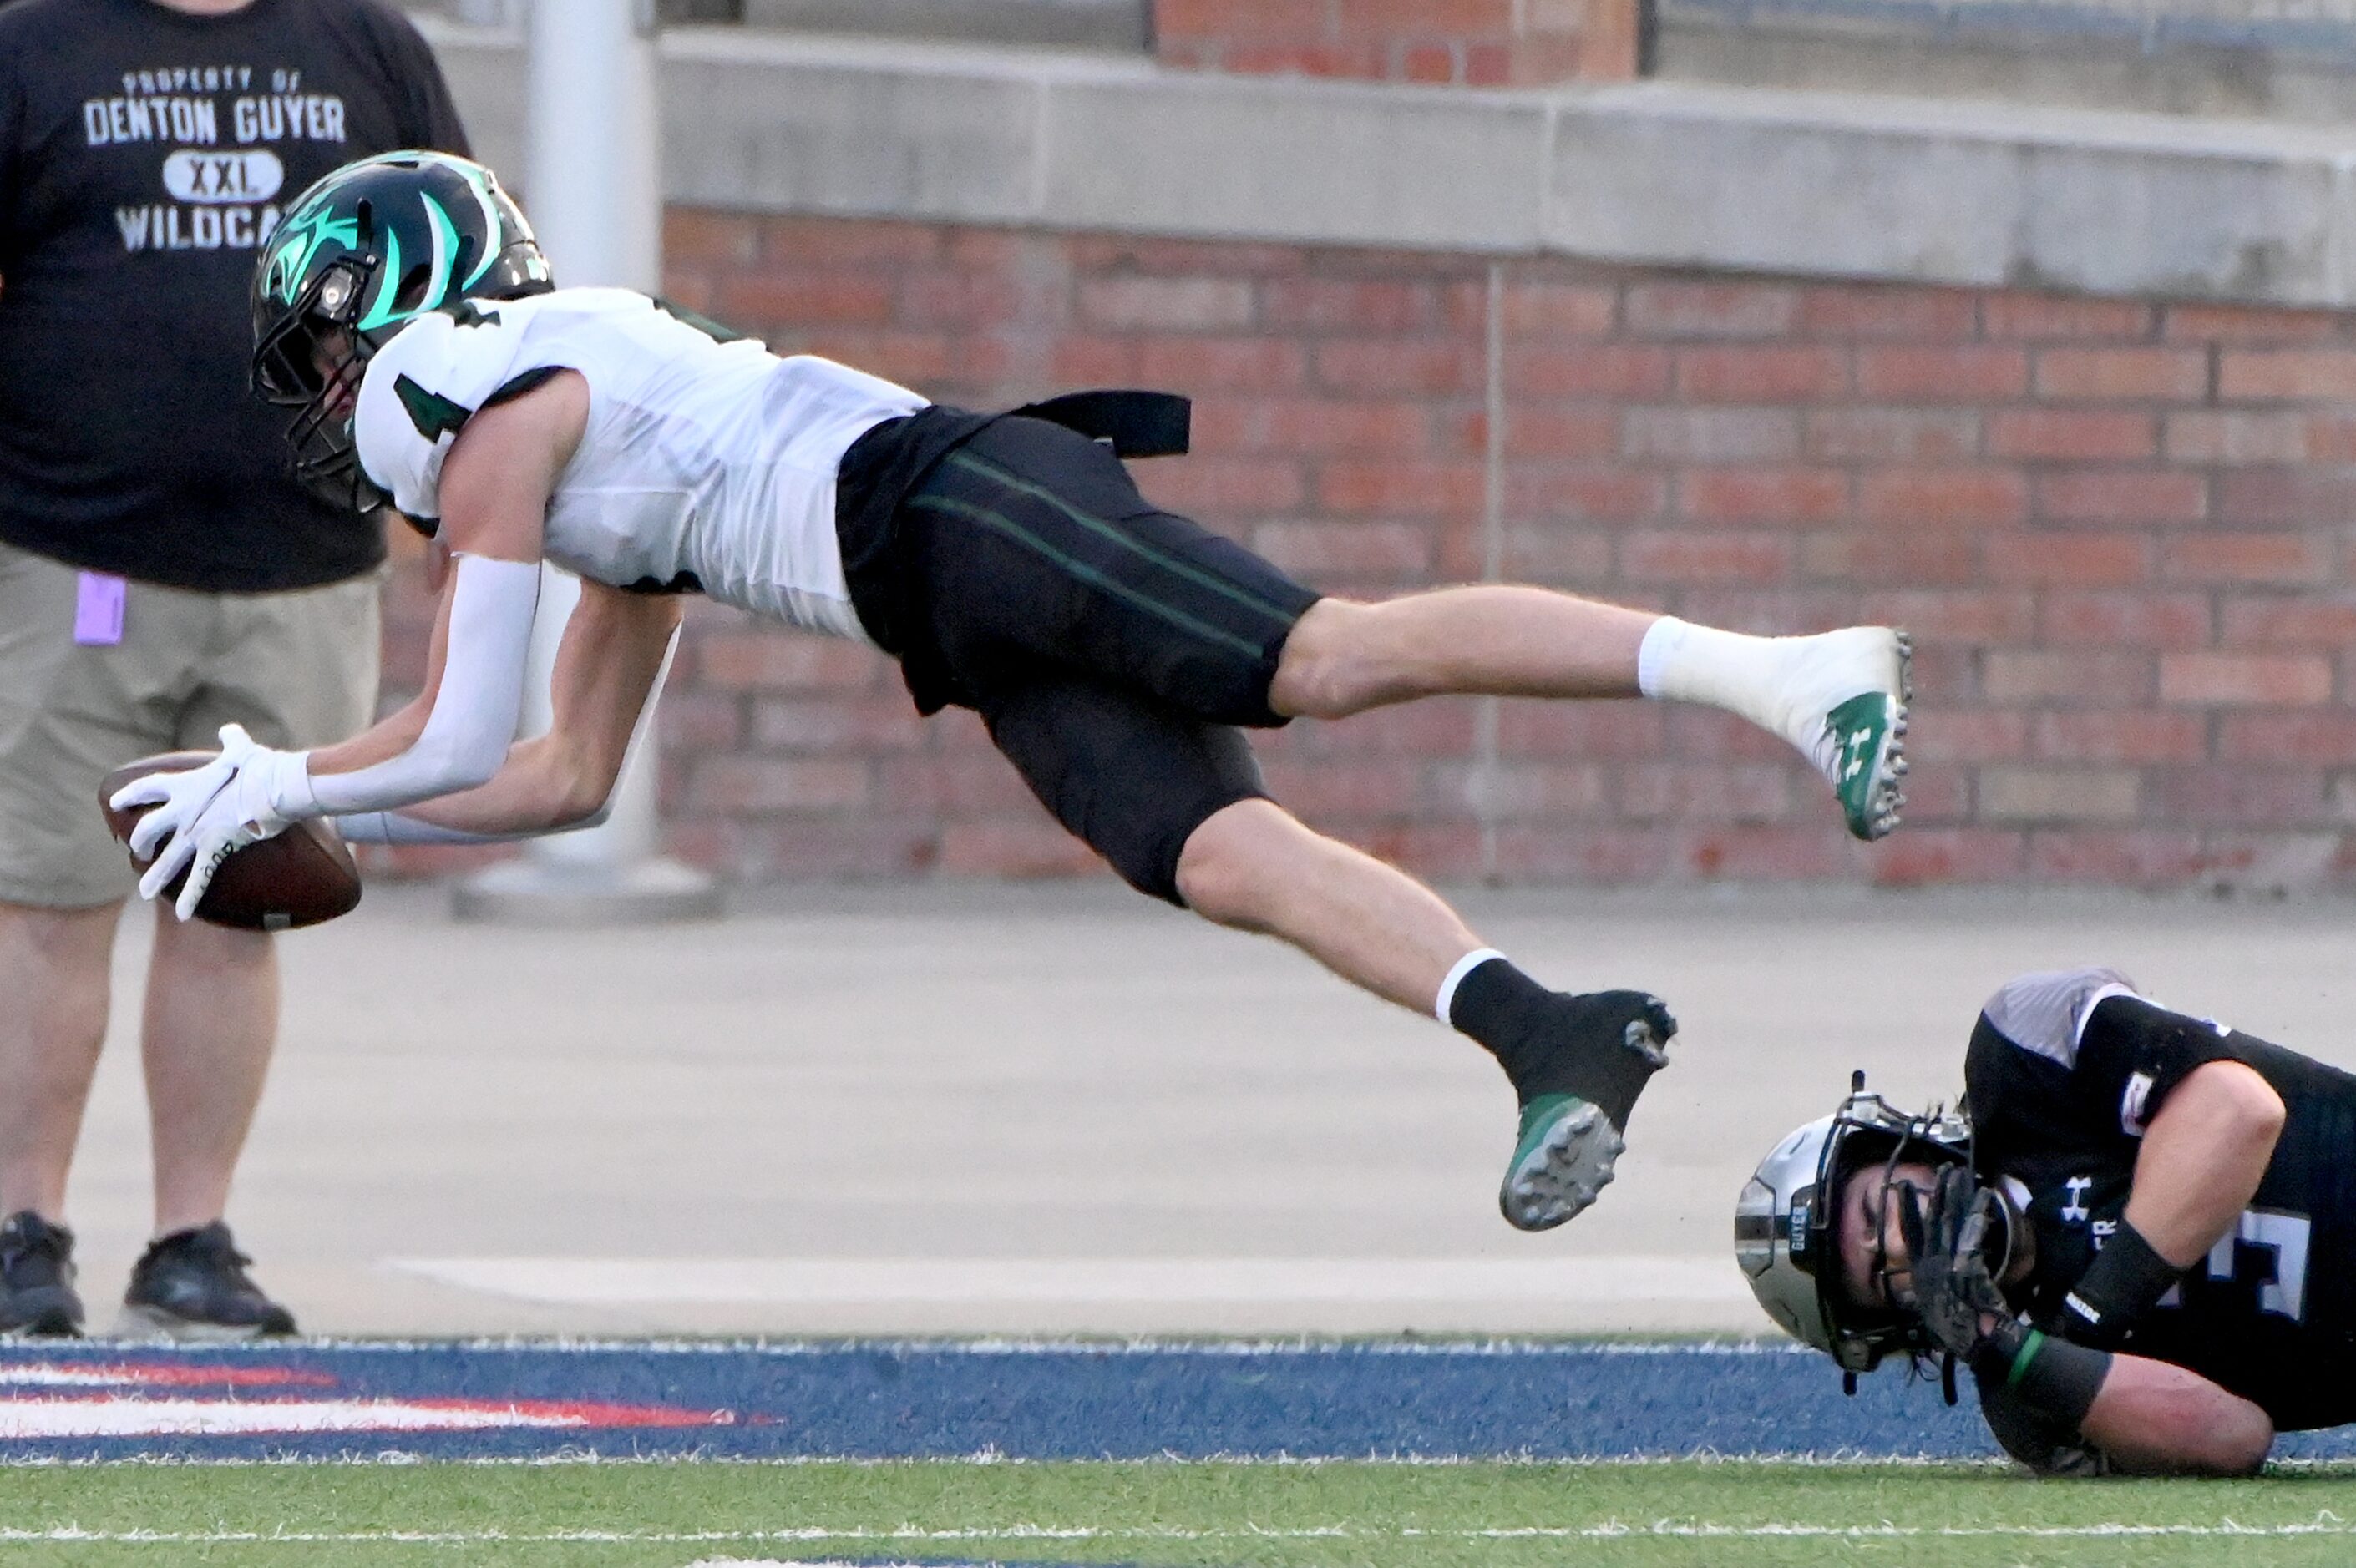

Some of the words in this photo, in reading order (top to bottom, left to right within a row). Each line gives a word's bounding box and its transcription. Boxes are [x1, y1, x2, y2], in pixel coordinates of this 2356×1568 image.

[122, 65, 251, 94] PROPERTY
[271, 68, 301, 94] OF
[84, 97, 217, 145] DENTON
[234, 94, 347, 144] GUYER
[189, 158, 259, 195] XXL
[116, 205, 282, 252] WILDCA
[1791, 1206, 1808, 1251] GUYER
